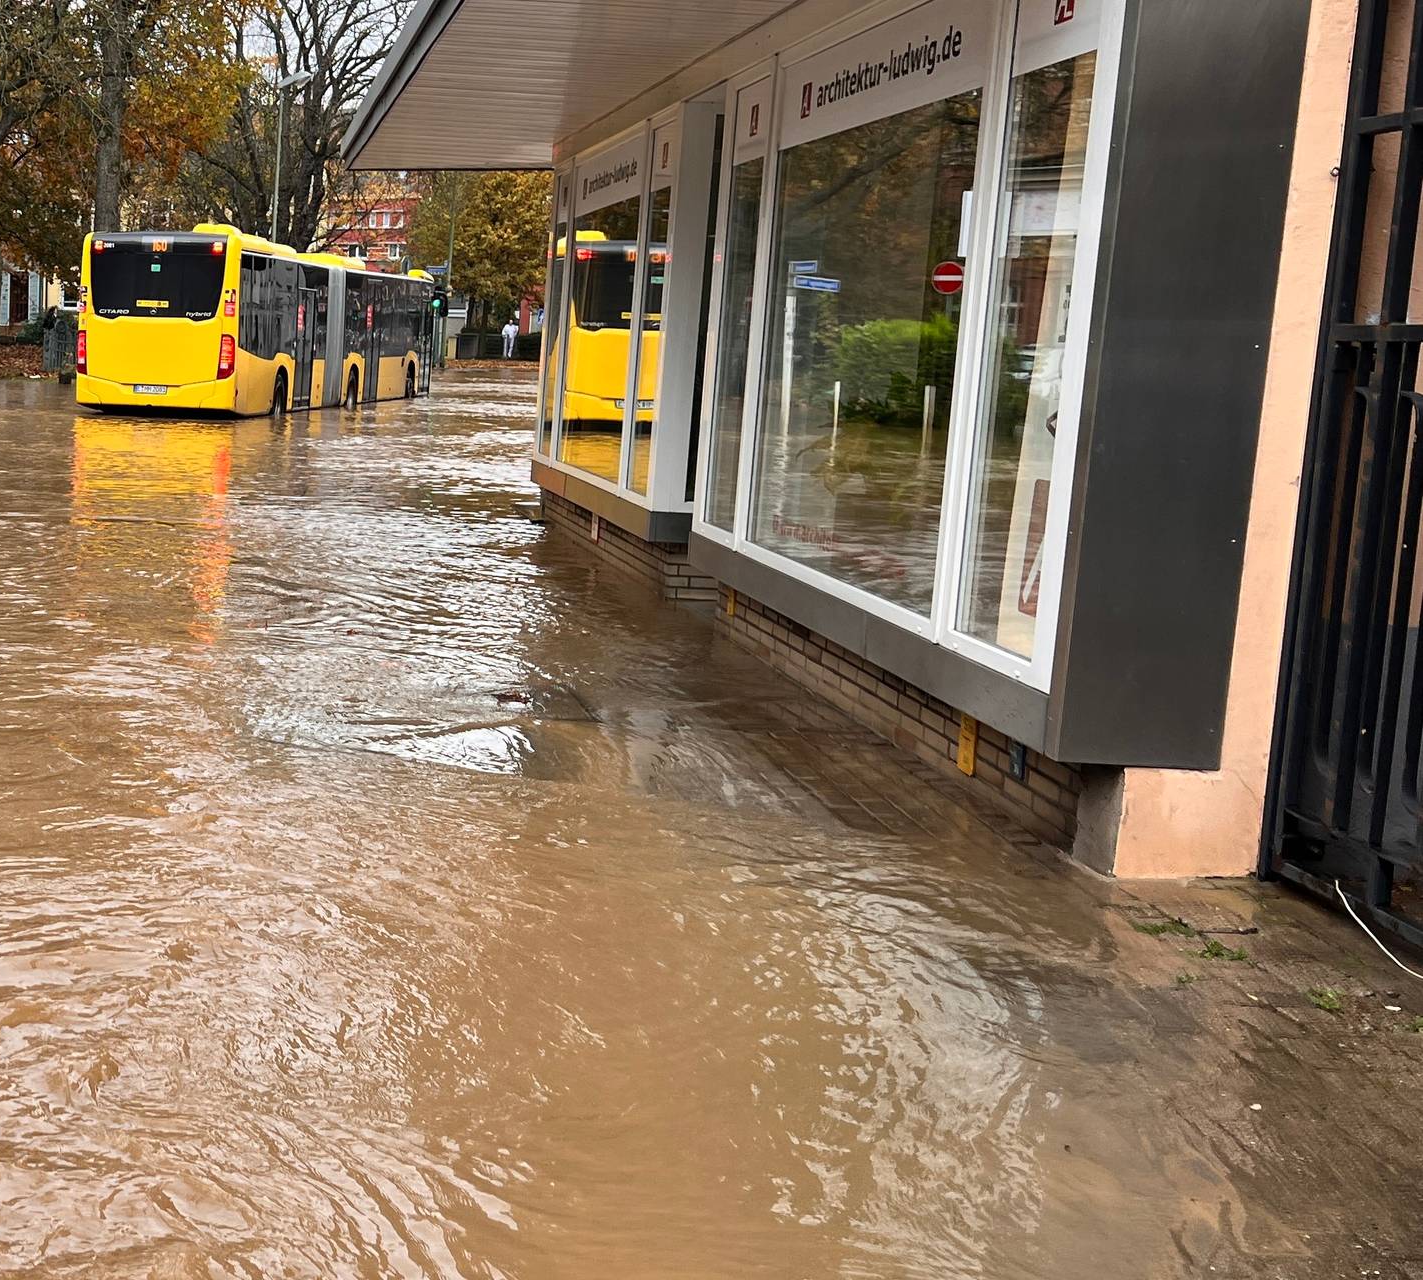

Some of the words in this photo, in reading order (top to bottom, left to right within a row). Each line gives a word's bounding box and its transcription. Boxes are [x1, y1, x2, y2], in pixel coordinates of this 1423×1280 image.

[816, 25, 962, 107] architektur-ludwig.de
[588, 157, 638, 194] architektur-ludwig.de
[152, 239, 168, 252] 160
